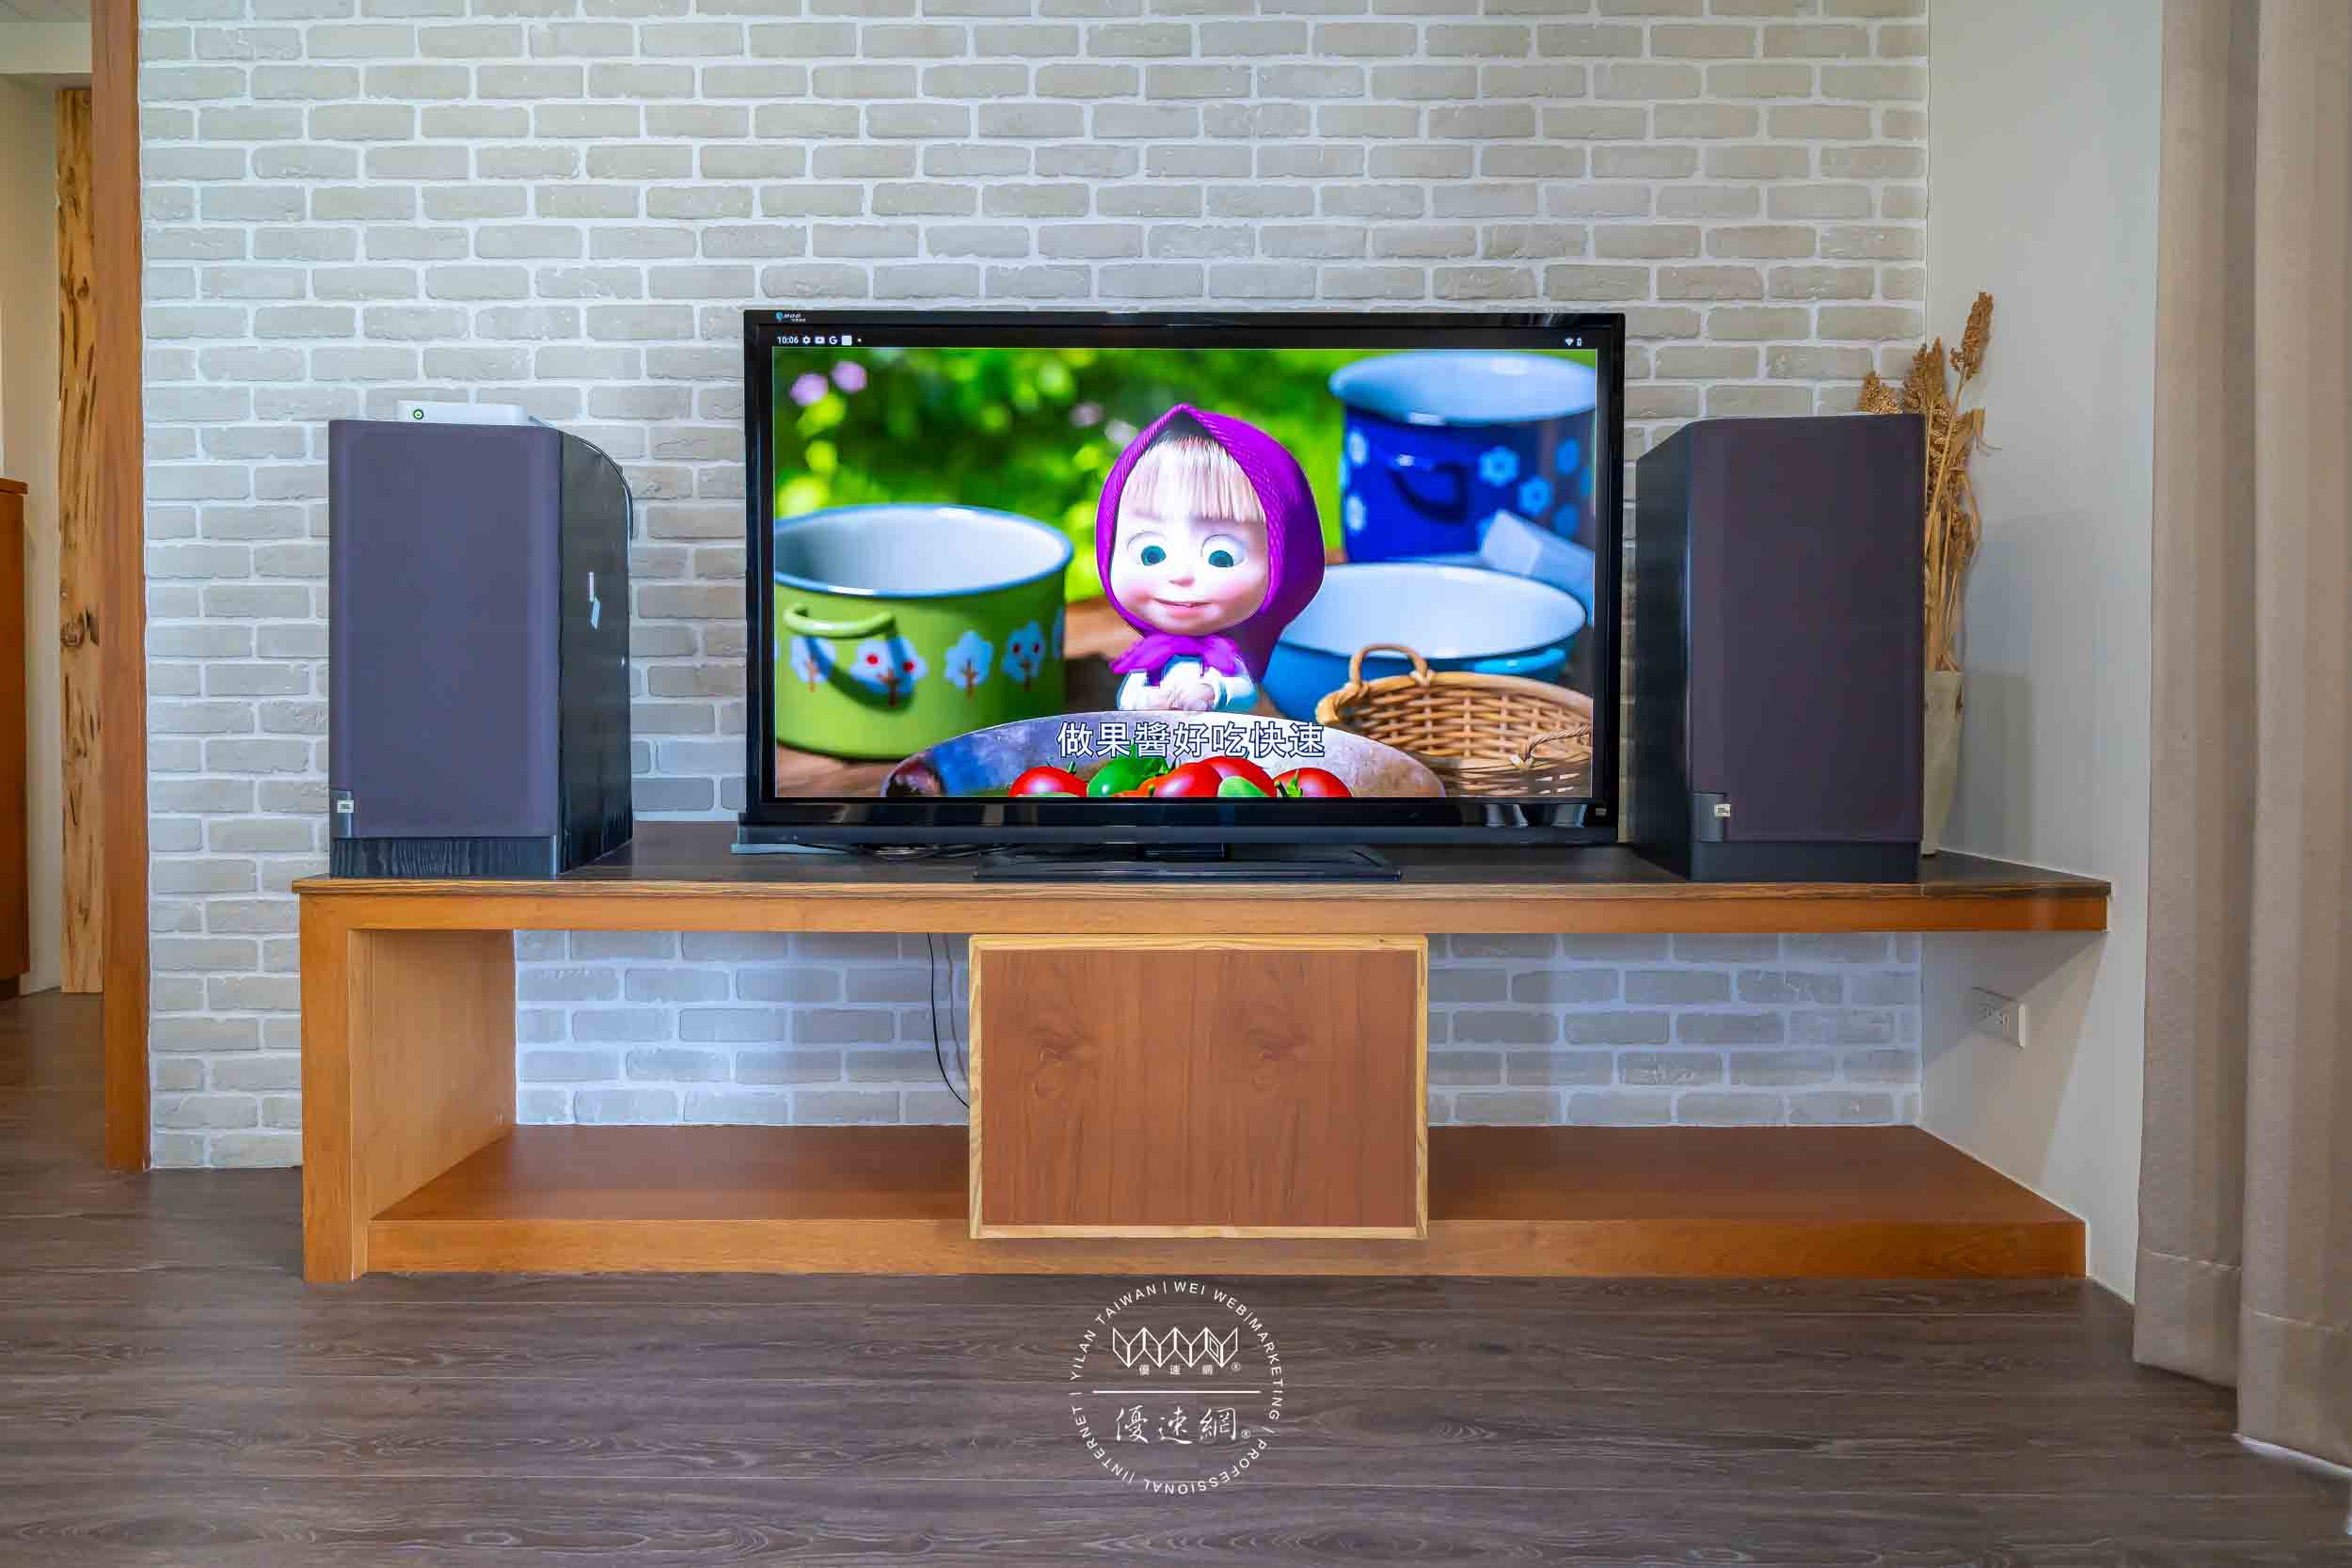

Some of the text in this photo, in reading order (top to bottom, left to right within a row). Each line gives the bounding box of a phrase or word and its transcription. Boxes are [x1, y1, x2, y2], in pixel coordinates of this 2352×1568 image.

[777, 336, 799, 344] 10:06
[1057, 721, 1325, 758] 做果醬好吃快速
